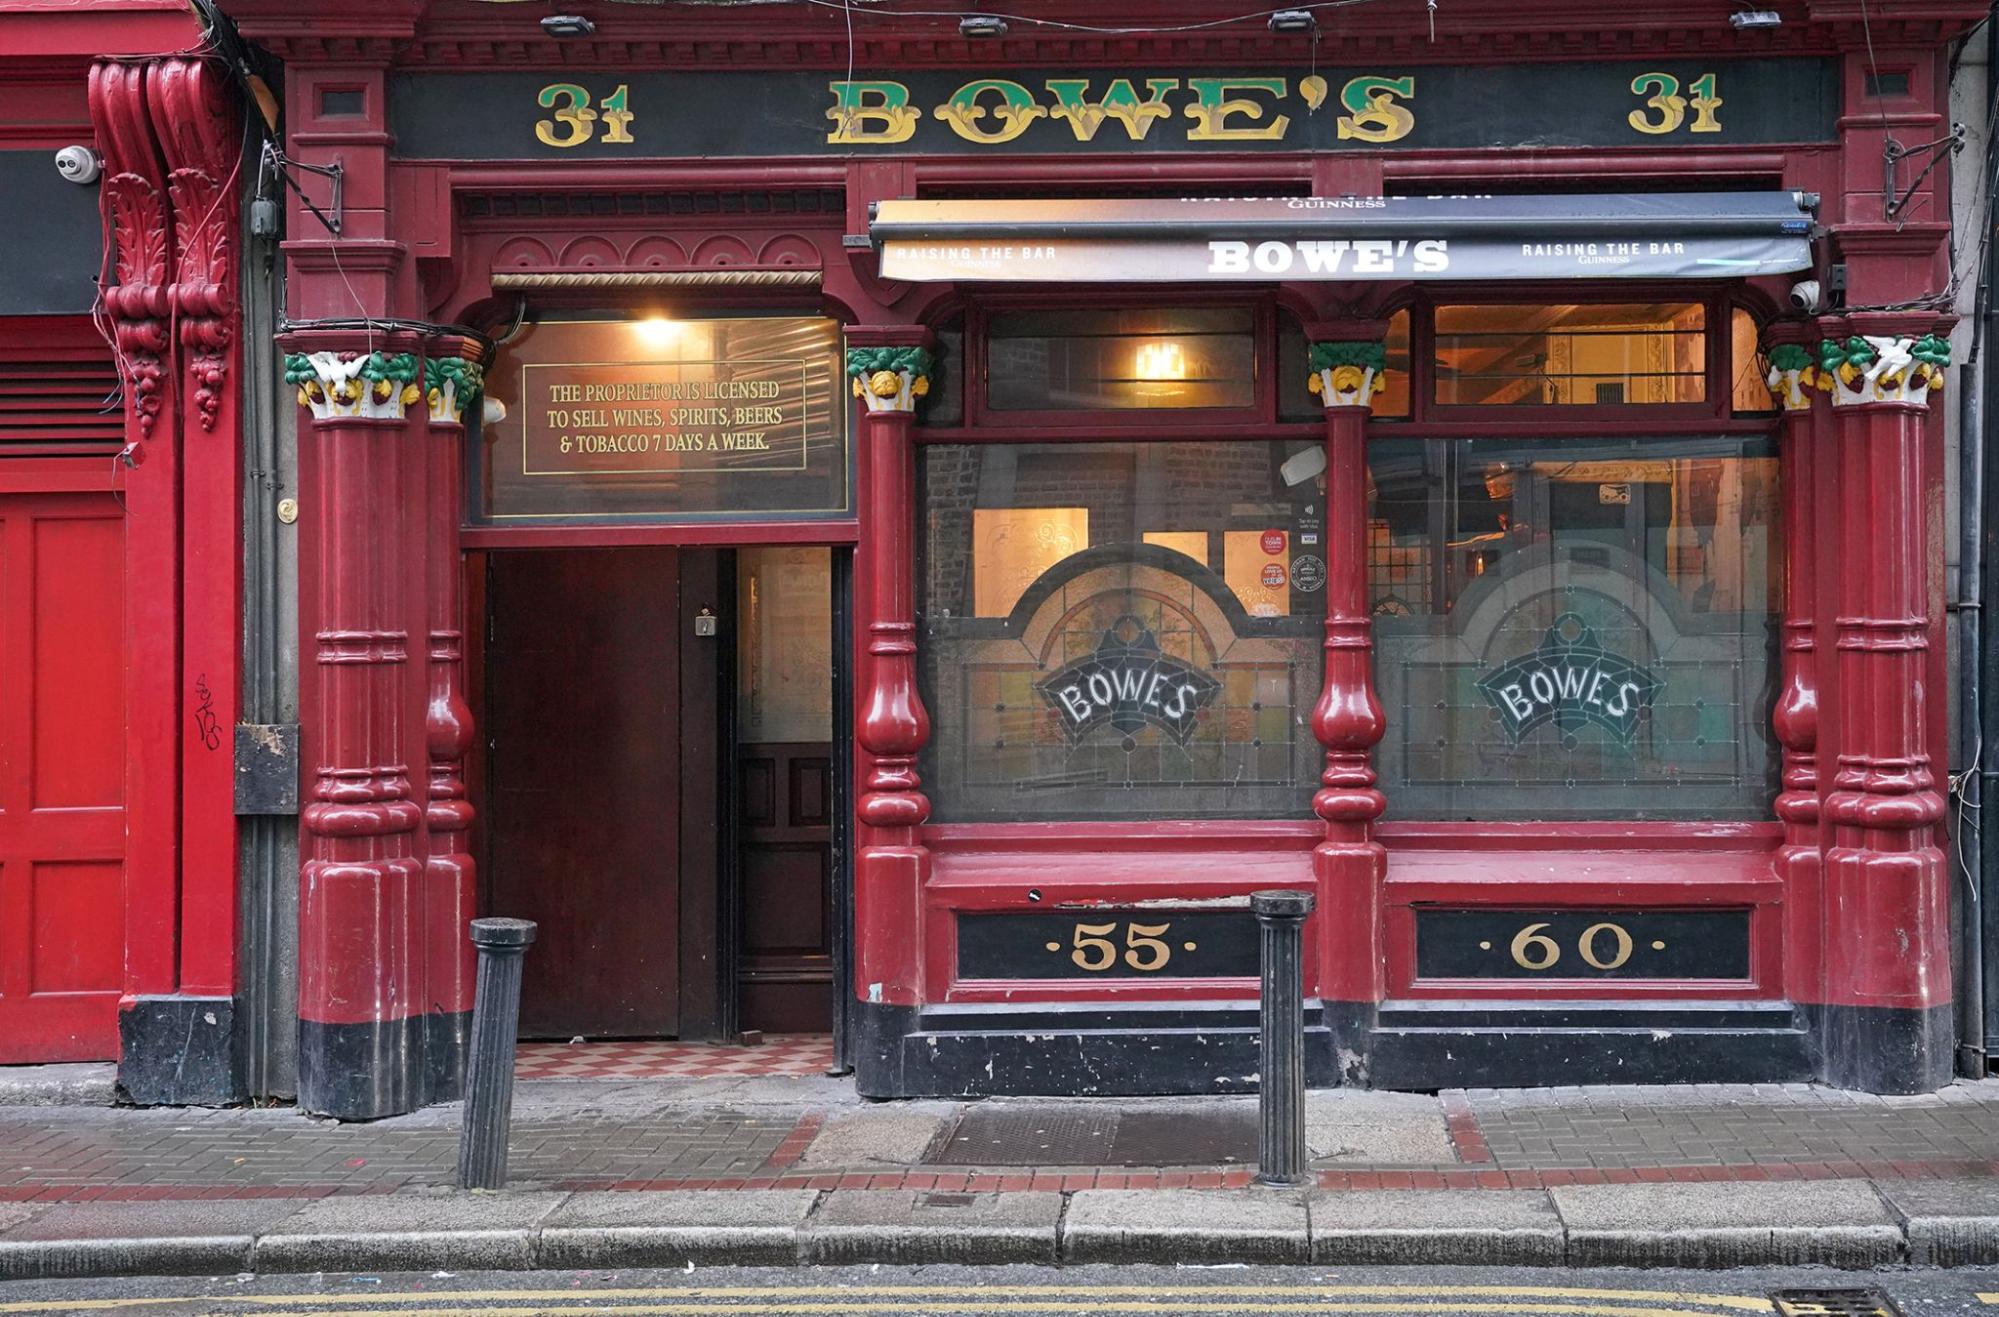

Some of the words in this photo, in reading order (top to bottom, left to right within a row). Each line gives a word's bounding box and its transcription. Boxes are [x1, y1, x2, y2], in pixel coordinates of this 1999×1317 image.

[535, 83, 635, 147] 31
[825, 76, 1415, 144] BOWE'S
[1628, 72, 1723, 134] 31
[1288, 200, 1386, 209] GUINNESS
[896, 248, 971, 260] RAISING
[980, 247, 1013, 260] THE
[1022, 247, 1056, 260] BAR
[1208, 240, 1449, 273] BOWE'S
[1522, 243, 1602, 257] RAISING
[1606, 243, 1641, 256] THE
[1650, 242, 1685, 255] BAR
[1578, 255, 1630, 265] GUINNESS
[550, 384, 580, 403] THE
[585, 382, 683, 402] PROPRIETOR
[686, 382, 699, 401] IS
[704, 381, 780, 400] LICENSED
[547, 410, 569, 428] TO
[572, 409, 609, 428] SELL
[612, 408, 666, 429] WINES,
[670, 407, 732, 428] SPIRITS,
[735, 406, 783, 425] BEERS
[560, 436, 573, 454] &
[576, 434, 649, 453] TOBACCO
[653, 434, 661, 452] 7
[665, 433, 704, 451] DAYS
[707, 432, 718, 451] A
[722, 431, 770, 450] WEEK.
[1059, 669, 1198, 722] BOWES
[1500, 668, 1639, 721] BOWES
[1071, 922, 1171, 971] 55
[1511, 922, 1633, 970] 60
